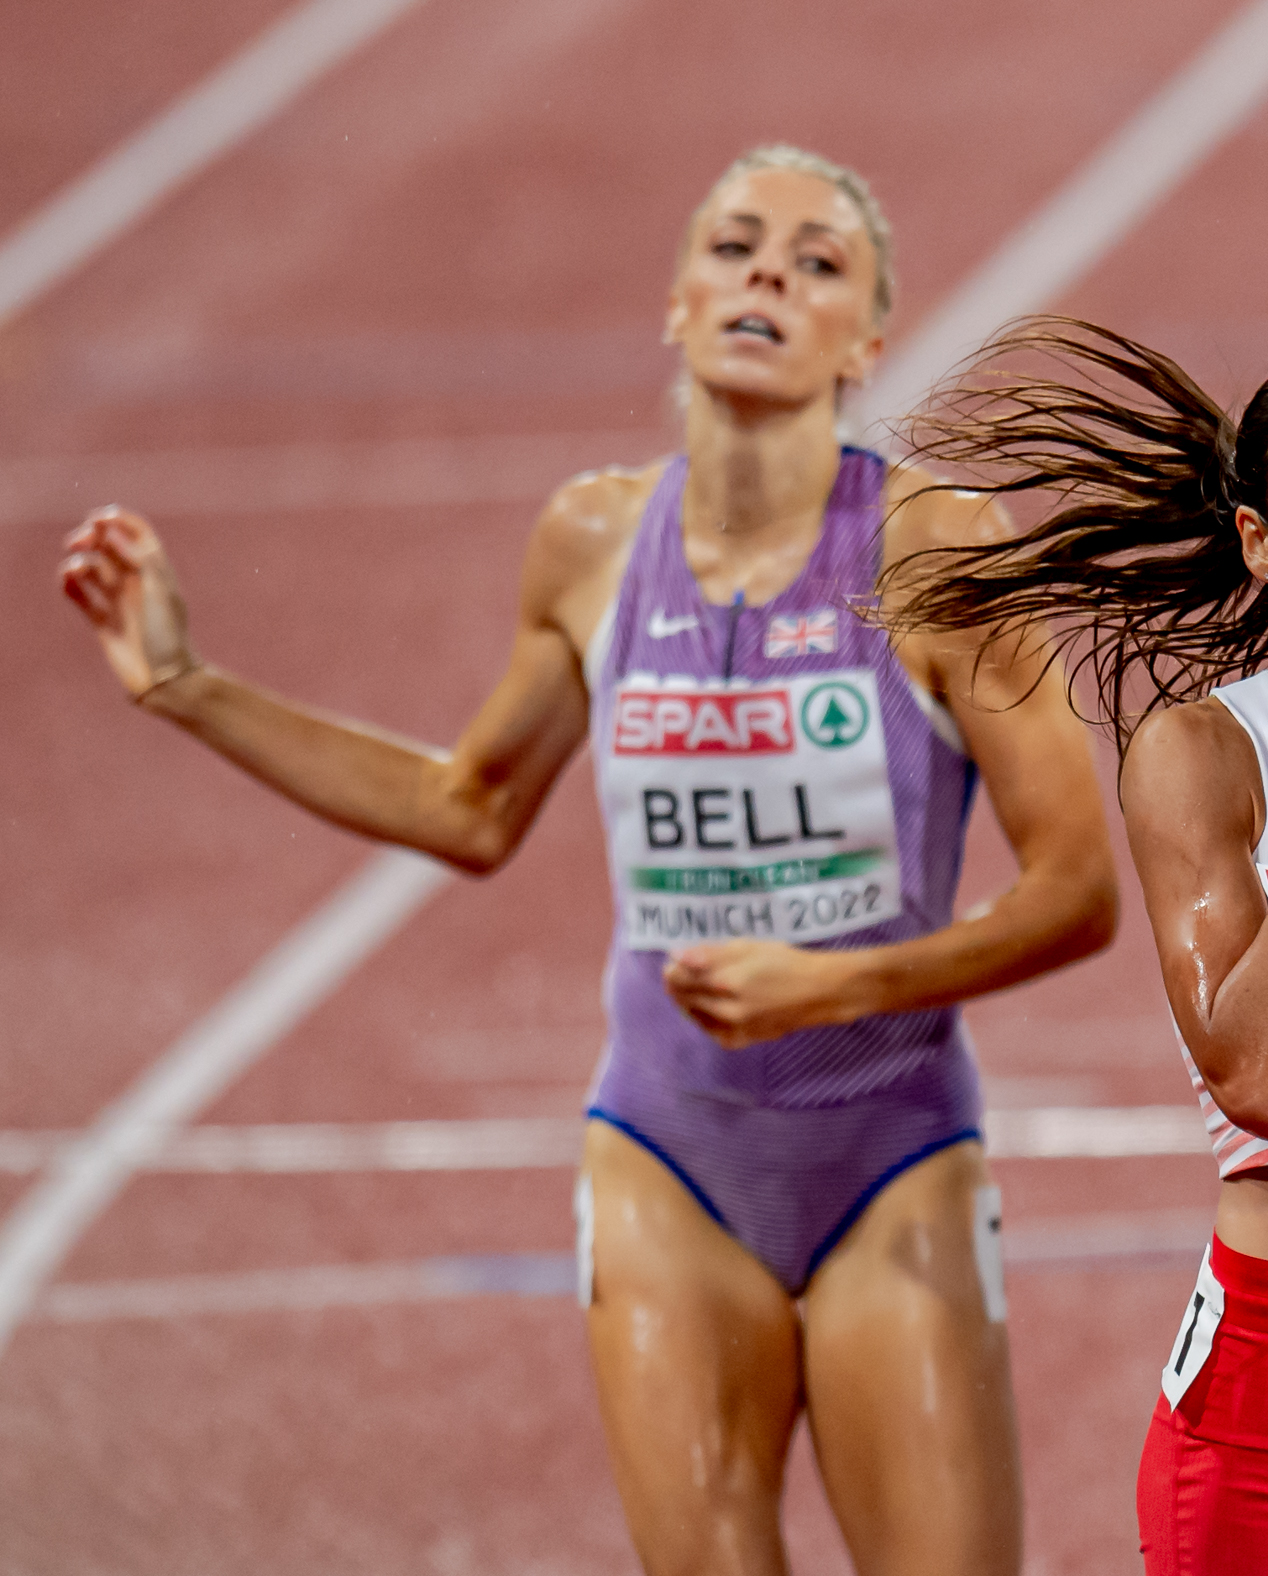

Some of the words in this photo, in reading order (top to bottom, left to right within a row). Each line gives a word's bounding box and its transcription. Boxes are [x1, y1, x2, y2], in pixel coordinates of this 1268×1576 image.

[617, 698, 790, 750] SPAR
[642, 783, 846, 851] BELL
[636, 902, 776, 938] MUNICH
[786, 883, 882, 932] 2022
